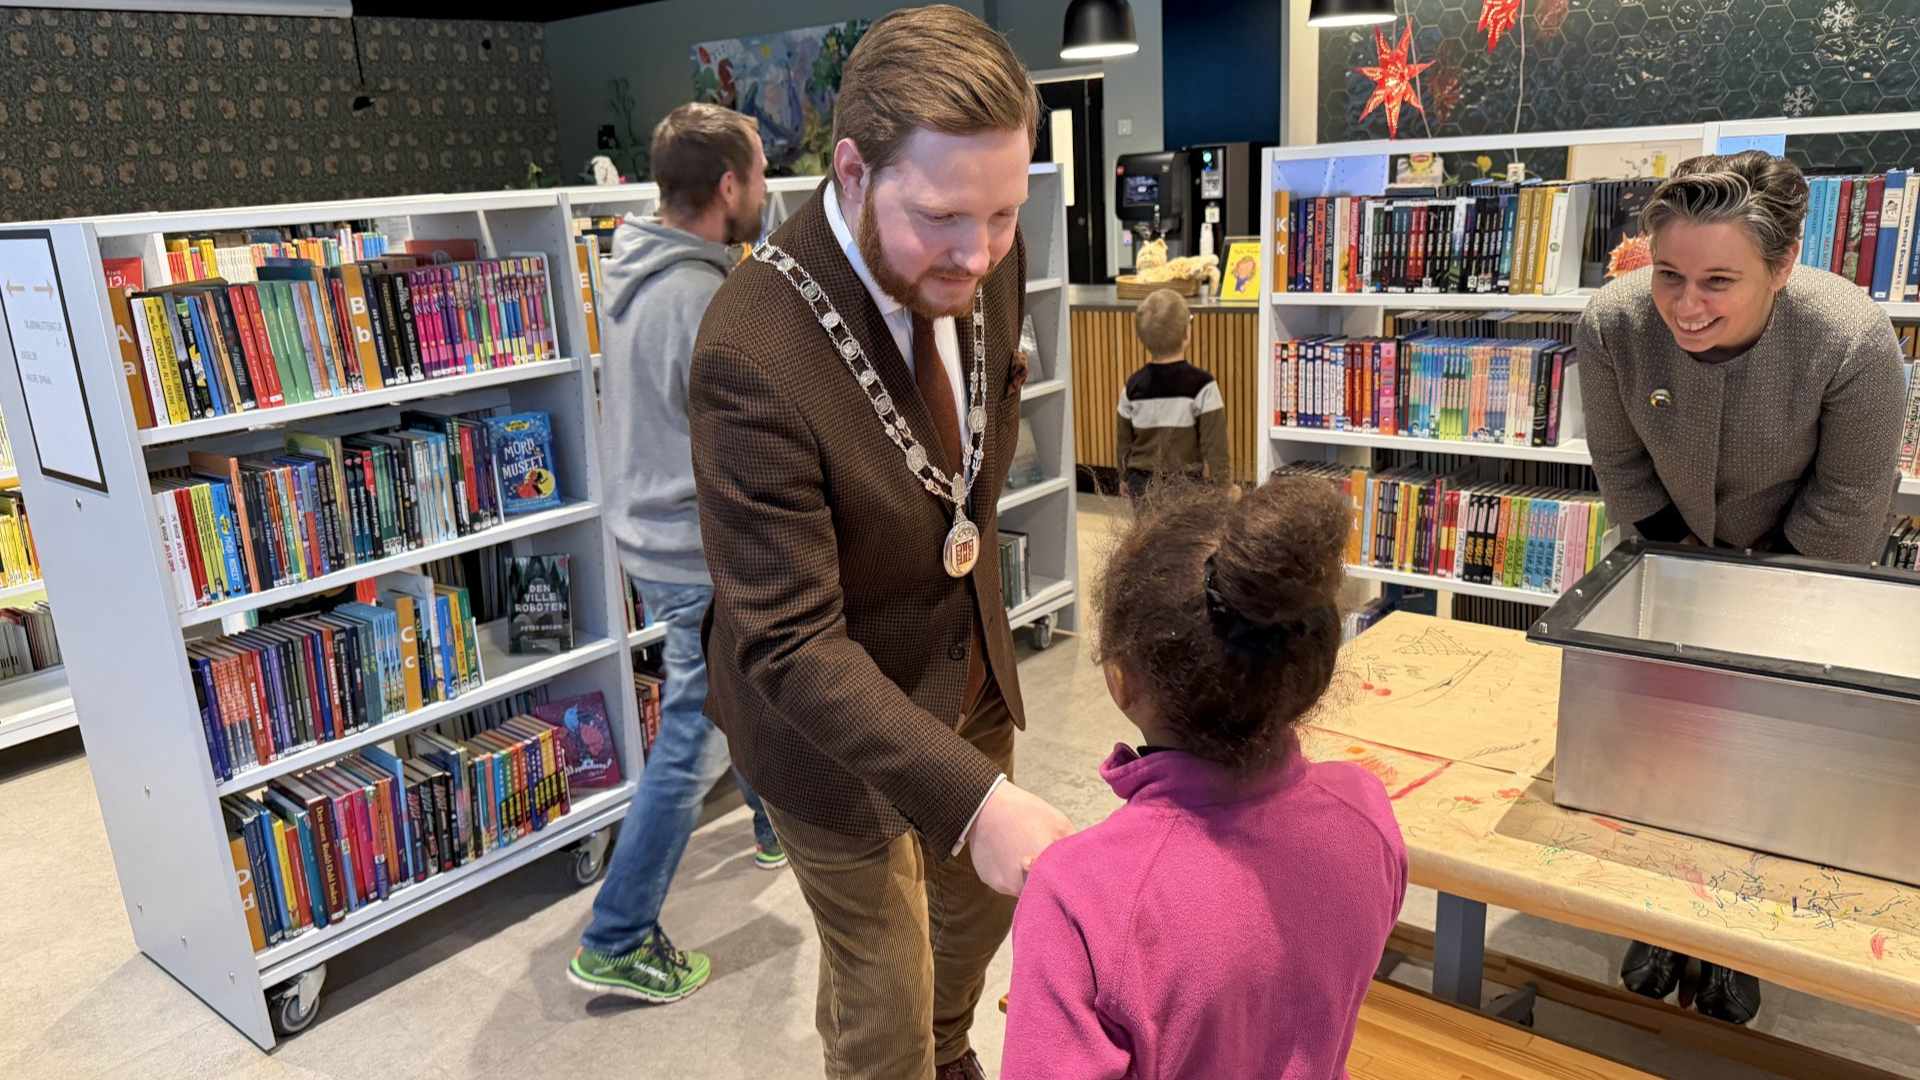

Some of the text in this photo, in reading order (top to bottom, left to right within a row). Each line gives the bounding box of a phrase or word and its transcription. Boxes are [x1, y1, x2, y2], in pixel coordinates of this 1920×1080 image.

[1276, 216, 1287, 232] K
[350, 296, 365, 316] B
[115, 323, 134, 344] A
[356, 326, 371, 343] b
[504, 438, 535, 460] MORD
[502, 456, 544, 480] MUSEET
[524, 593, 557, 602] VILLE
[528, 584, 551, 593] DEN
[514, 602, 567, 613] ROBOTEN
[401, 626, 414, 642] C
[405, 655, 416, 668] c
[315, 805, 326, 824] Den
[320, 842, 333, 864] Roald
[324, 863, 335, 882] Dahl
